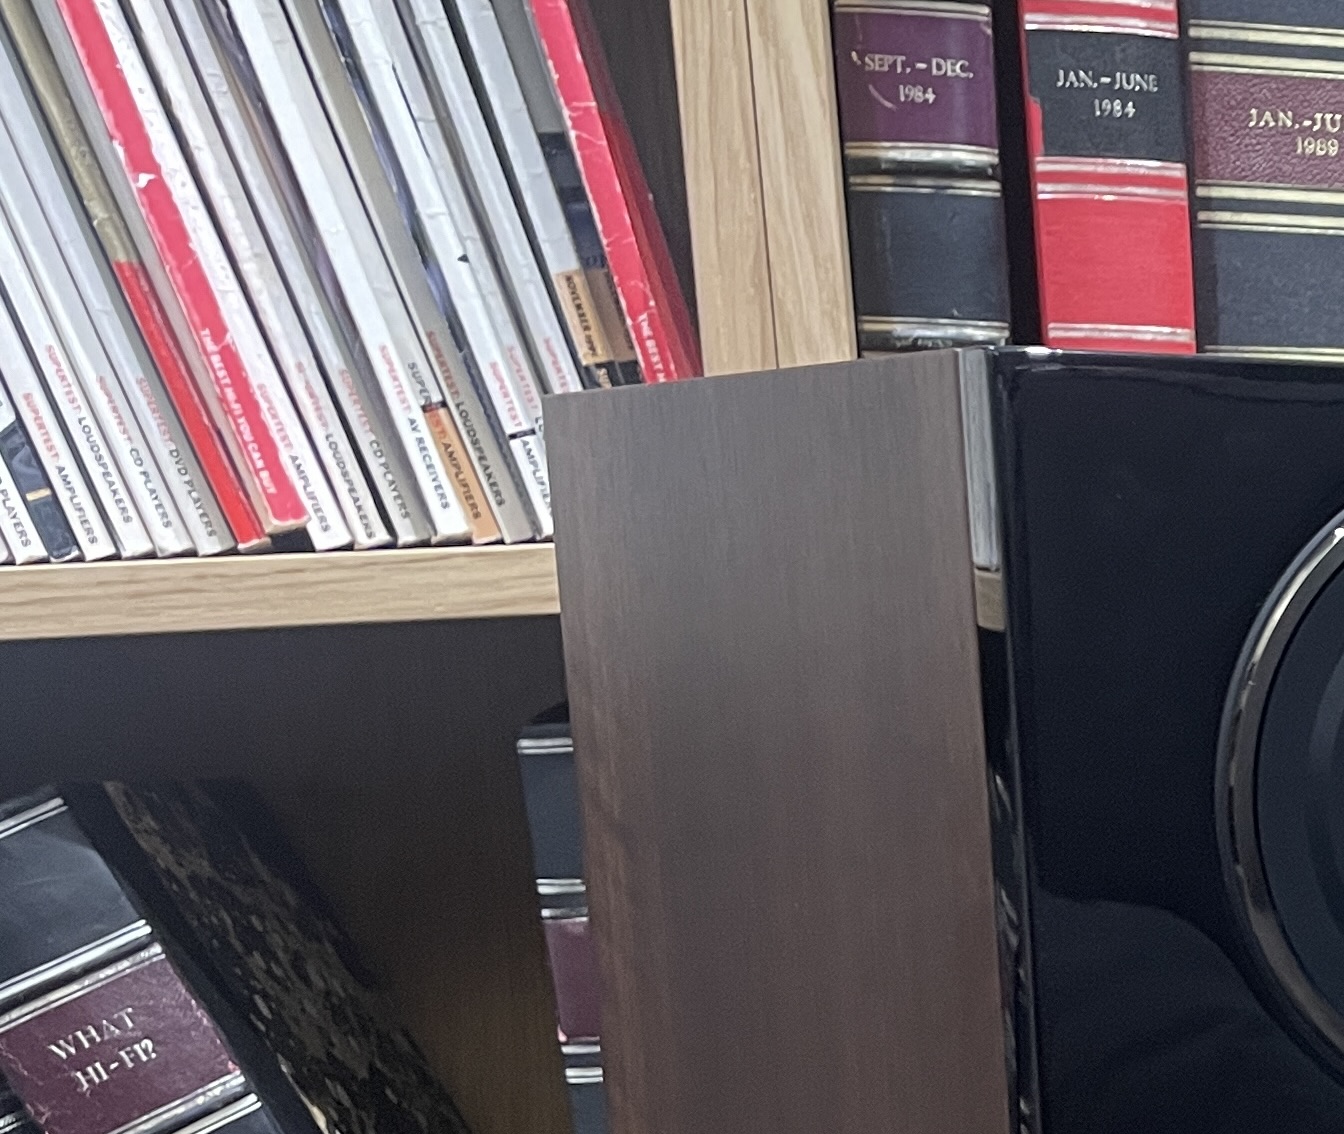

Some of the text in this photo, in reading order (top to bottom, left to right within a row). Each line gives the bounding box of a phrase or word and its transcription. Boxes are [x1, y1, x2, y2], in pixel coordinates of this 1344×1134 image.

[899, 85, 936, 105] 1984
[1093, 98, 1136, 119] 1984
[78, 416, 132, 524] LOUDSPEAKERS
[130, 448, 143, 467] CD
[140, 470, 172, 528] PLAYERS
[169, 448, 188, 476] DVD
[184, 476, 217, 537] PLAYERS
[289, 454, 331, 533] AMPLIFIERS
[325, 433, 376, 539] LOUDSPEAKERS
[370, 440, 384, 458] CD
[379, 462, 411, 519] PLAYERS
[408, 417, 421, 434] AV
[415, 437, 450, 509] RECEIVERS
[442, 442, 482, 520] AMPLIFIERS
[456, 402, 505, 506] LOUDSPEAKERS
[56, 465, 98, 544] AMPLIFIERS
[49, 1007, 133, 1060] WHAT
